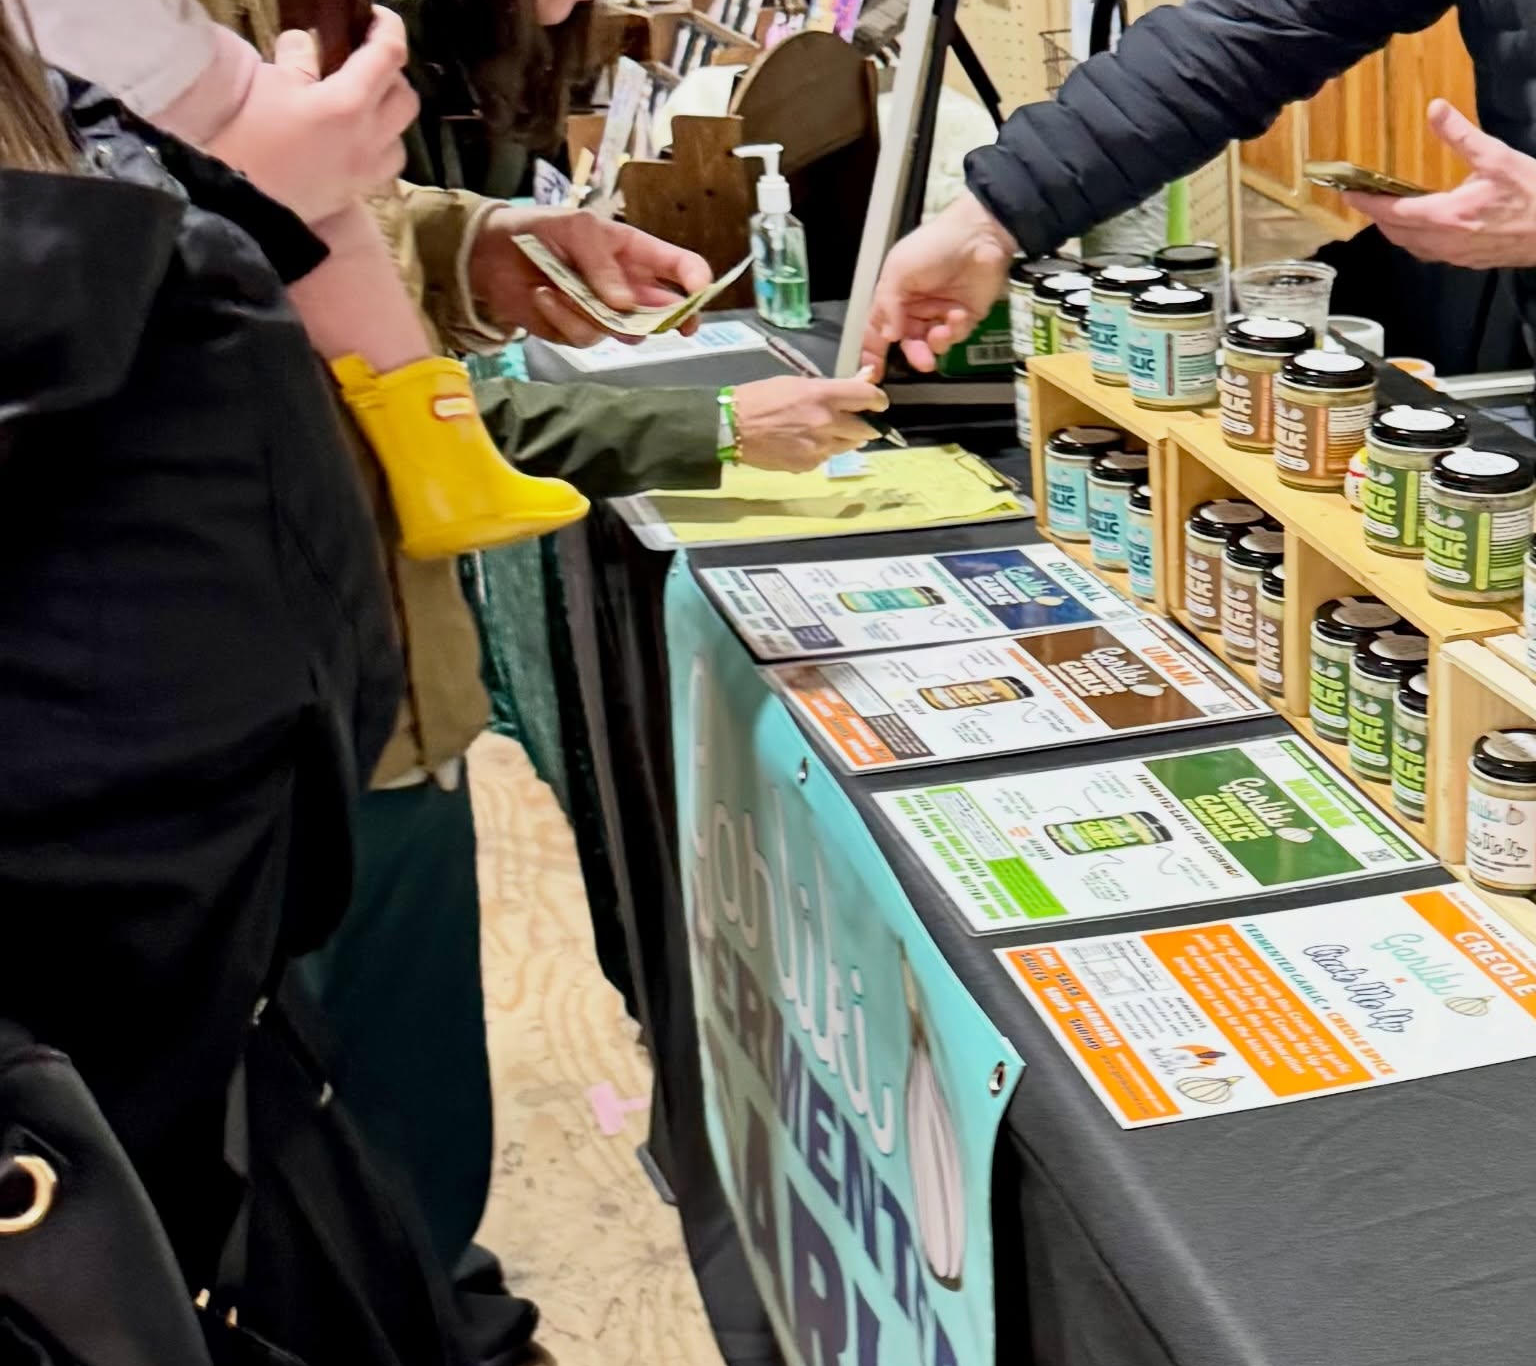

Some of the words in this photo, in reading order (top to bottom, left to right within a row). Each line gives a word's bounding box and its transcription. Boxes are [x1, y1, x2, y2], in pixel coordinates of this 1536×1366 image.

[1044, 562, 1111, 601] ORIGINAL
[1056, 660, 1115, 696] GARLIC
[1081, 647, 1150, 688] Garliki
[1138, 646, 1205, 687] UMAMI
[1168, 809, 1196, 830] GARLIC
[1191, 793, 1259, 842] GARLIC
[1218, 777, 1296, 828] Garliki
[1016, 952, 1049, 981] SAUCES
[1053, 972, 1082, 997] SALSA
[1370, 933, 1465, 996] Garliki
[1239, 923, 1299, 973] FERMENTED
[1288, 973, 1329, 1004] GARLIC
[1325, 1012, 1371, 1047] CREOLE
[1359, 1047, 1397, 1075] SPICE
